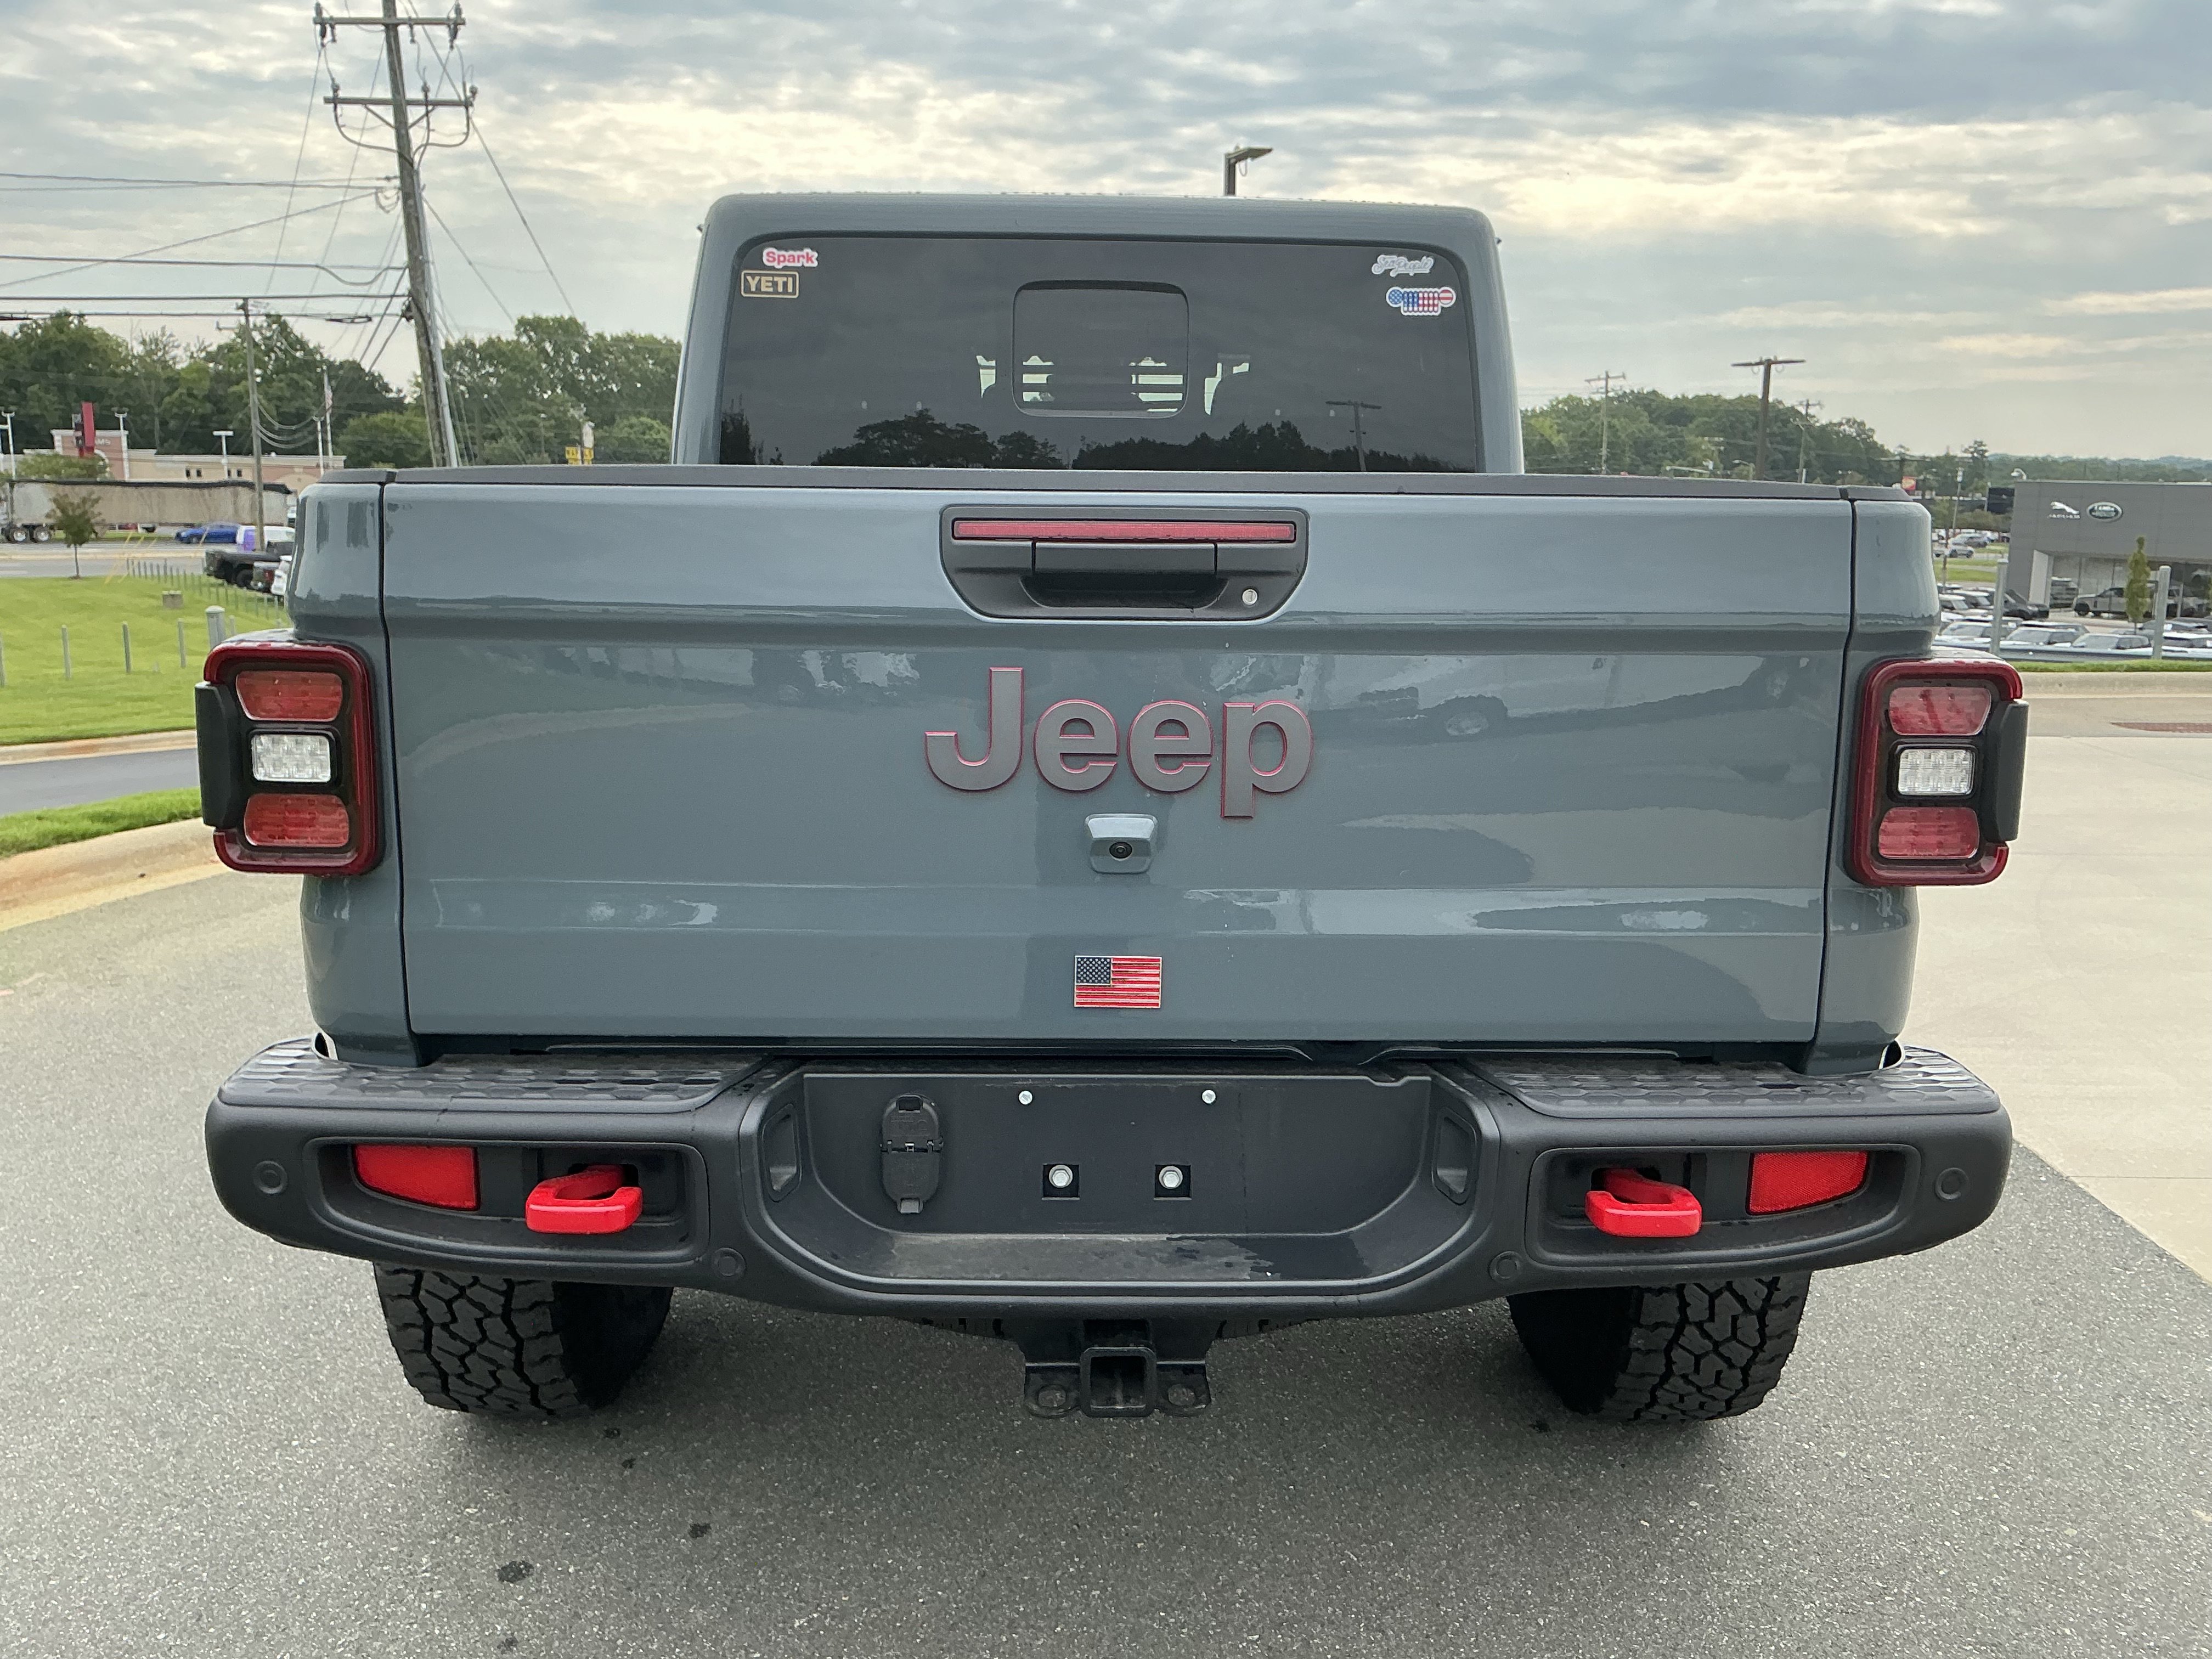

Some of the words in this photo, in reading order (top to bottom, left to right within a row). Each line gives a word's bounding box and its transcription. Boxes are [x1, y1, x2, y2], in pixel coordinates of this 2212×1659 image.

[766, 251, 815, 266] Spark
[746, 275, 793, 293] YETI
[924, 667, 1314, 819] Jeep
